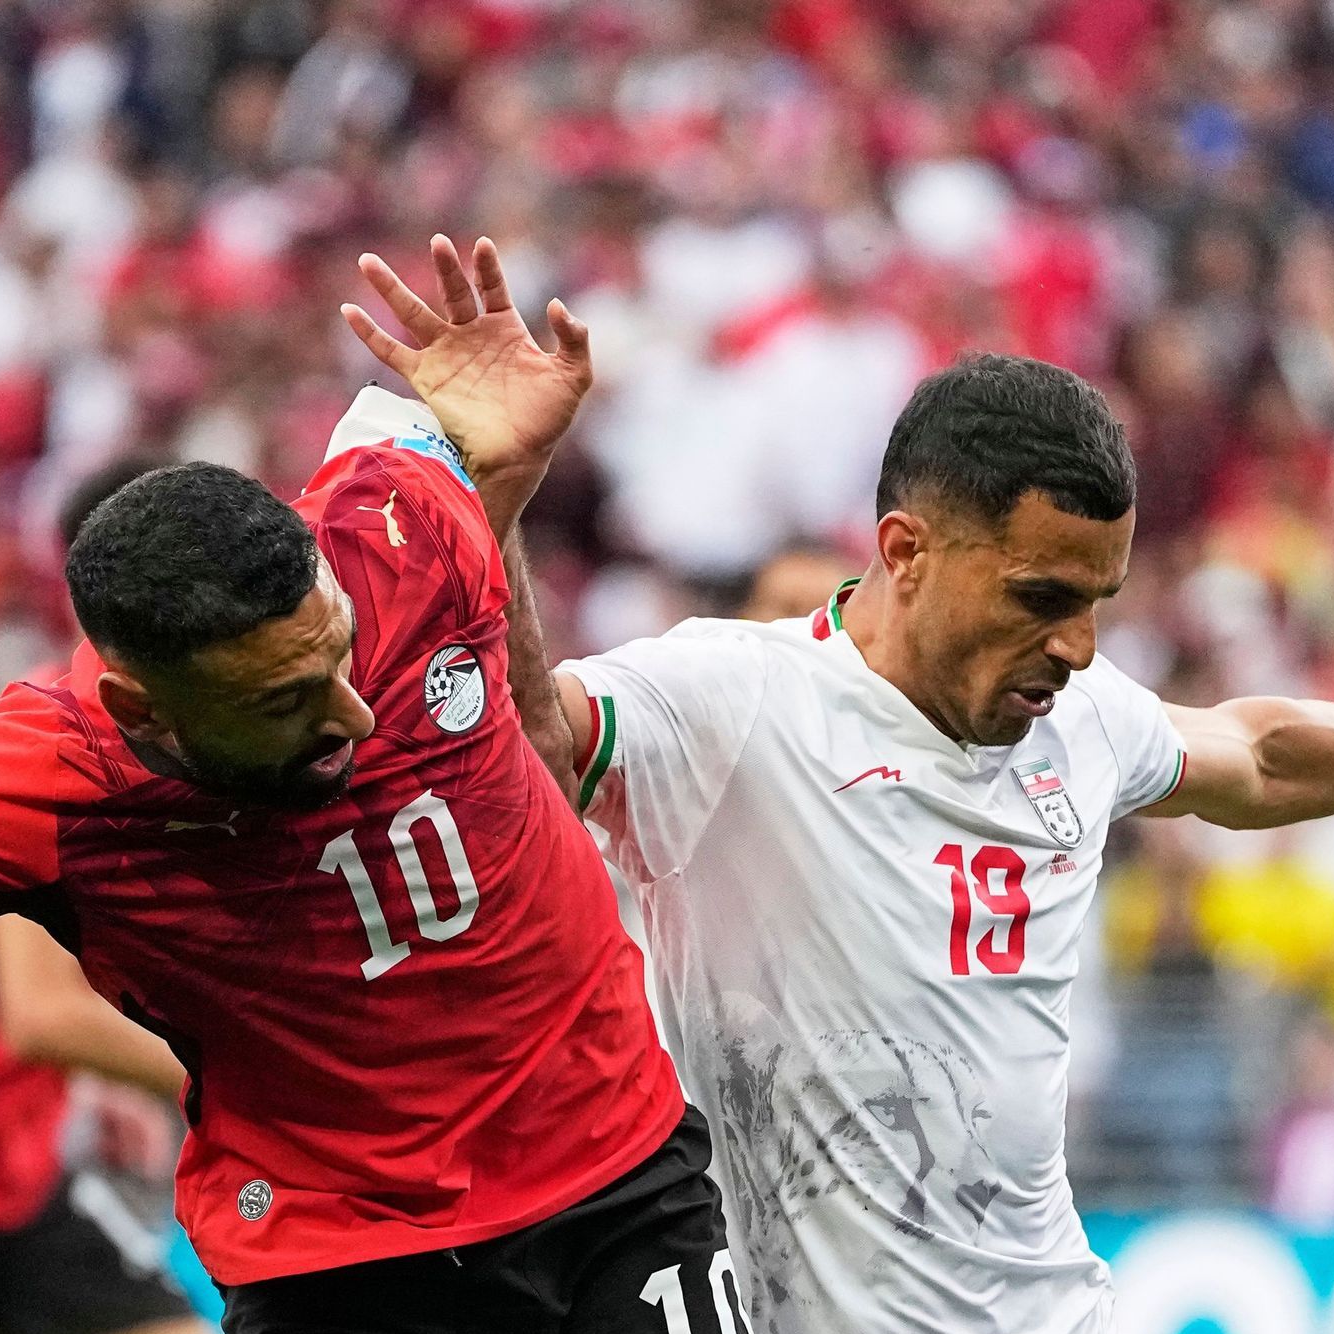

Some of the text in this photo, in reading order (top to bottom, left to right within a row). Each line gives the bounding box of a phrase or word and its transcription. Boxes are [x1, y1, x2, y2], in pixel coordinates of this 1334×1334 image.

[458, 705, 478, 726] EGYPTIAN
[316, 788, 480, 983] 10
[932, 843, 1032, 976] 19
